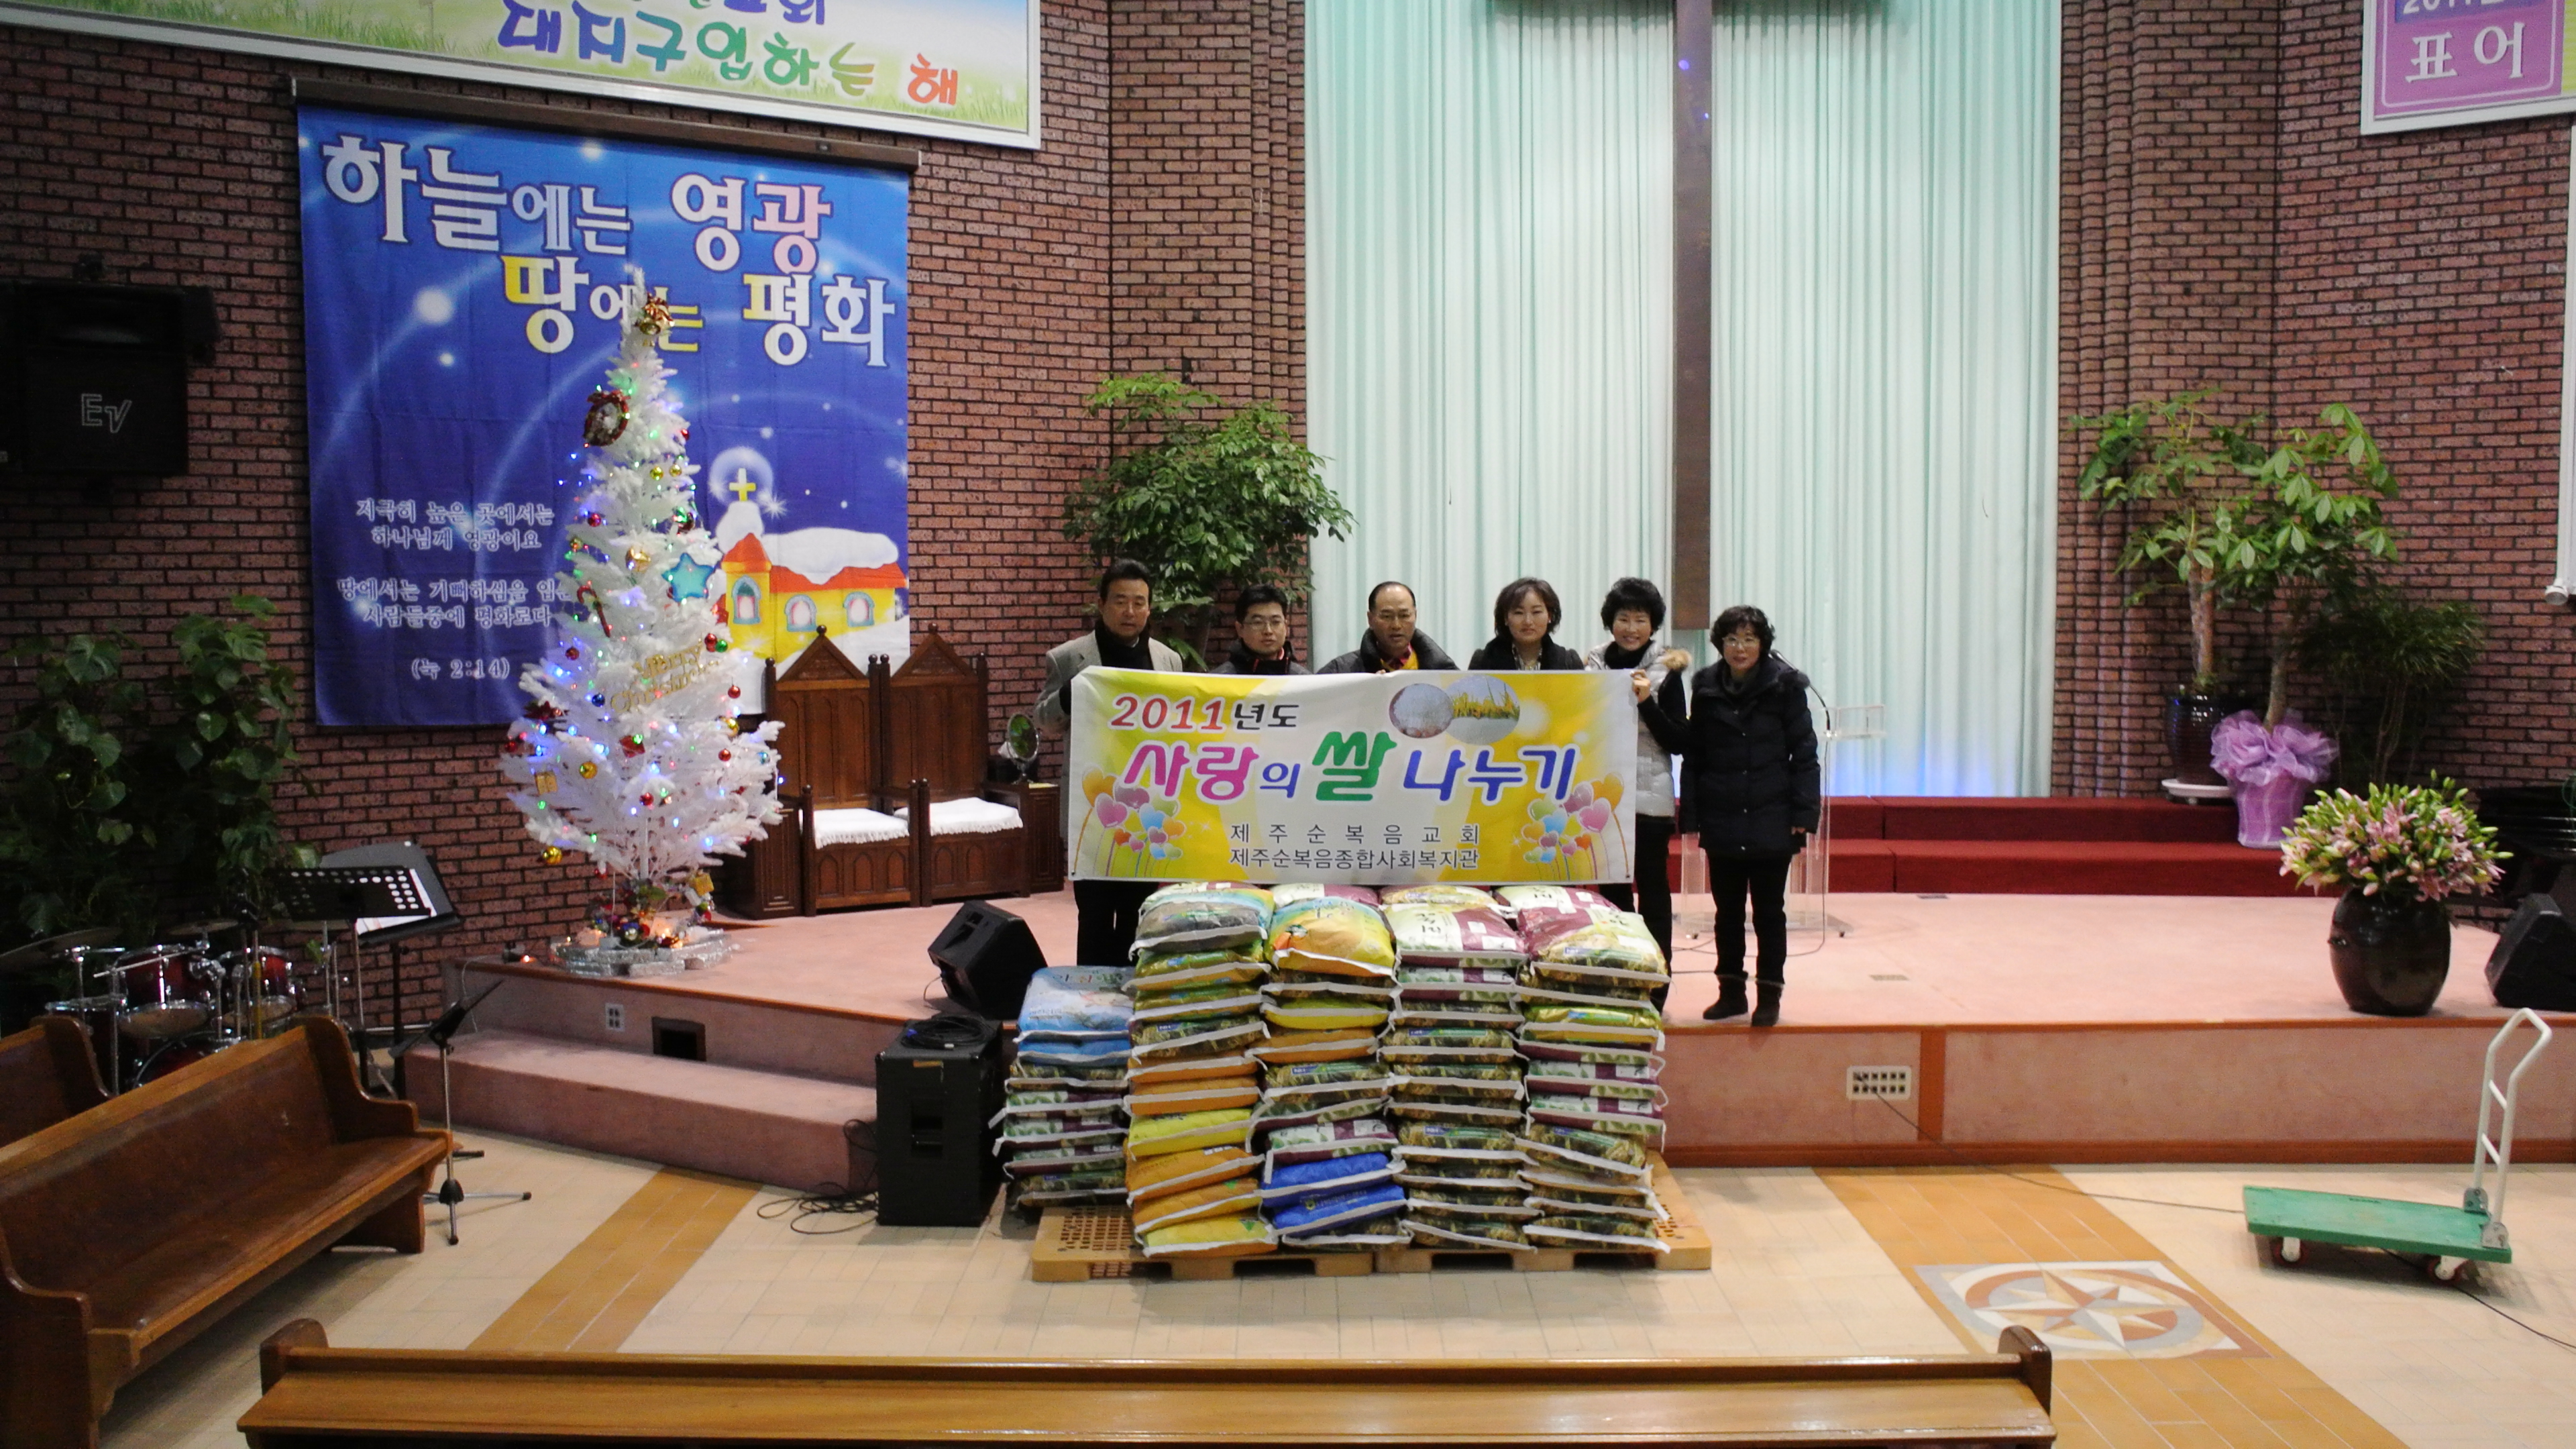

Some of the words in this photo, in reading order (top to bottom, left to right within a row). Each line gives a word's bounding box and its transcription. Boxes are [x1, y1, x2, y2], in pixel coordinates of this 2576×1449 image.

[907, 53, 958, 106] 해
[323, 135, 632, 256] 하늘에는
[672, 173, 831, 275] 영광
[742, 274, 896, 368] 평화
[356, 497, 417, 524] 지극히
[425, 501, 469, 525] 높은
[476, 502, 555, 527] 곳에서는
[371, 525, 453, 551] 하나님께
[463, 527, 542, 553] 영광이요
[337, 576, 421, 602] 땅에서는
[428, 578, 529, 603] 기뻐하심을
[362, 603, 466, 629] 사람들중에
[474, 603, 552, 629] 평화로다
[450, 657, 511, 680] 2:14)
[1110, 696, 1300, 731] 2011년도
[1123, 744, 1301, 801] 사랑의
[1311, 731, 1398, 802] 쌀
[1403, 747, 1576, 802] 나누기
[1230, 848, 1479, 871] 제주순복음종합사회복지관
